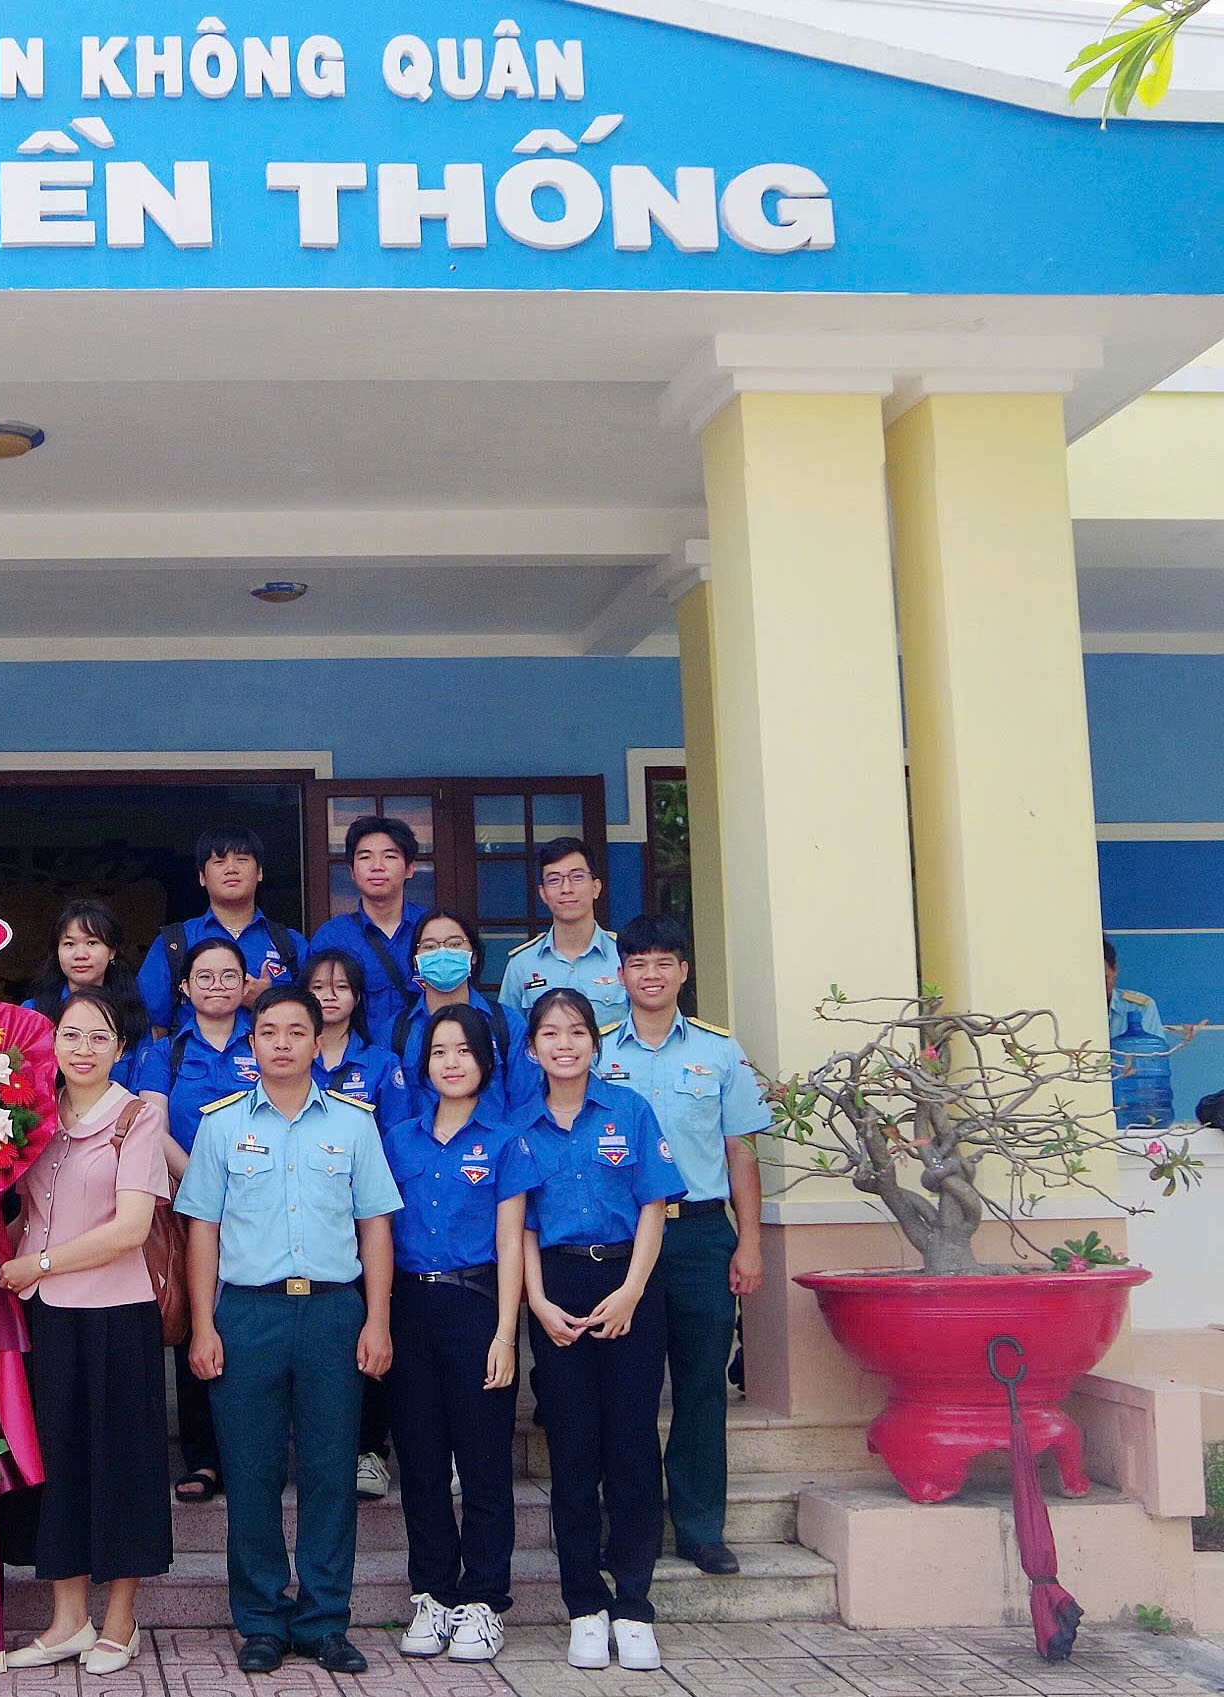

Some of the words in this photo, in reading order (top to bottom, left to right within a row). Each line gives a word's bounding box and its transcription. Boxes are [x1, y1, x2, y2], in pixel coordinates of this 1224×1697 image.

[81, 16, 345, 99] KHÔNG
[382, 19, 585, 103] QUÂN
[266, 113, 836, 253] THỐNG
